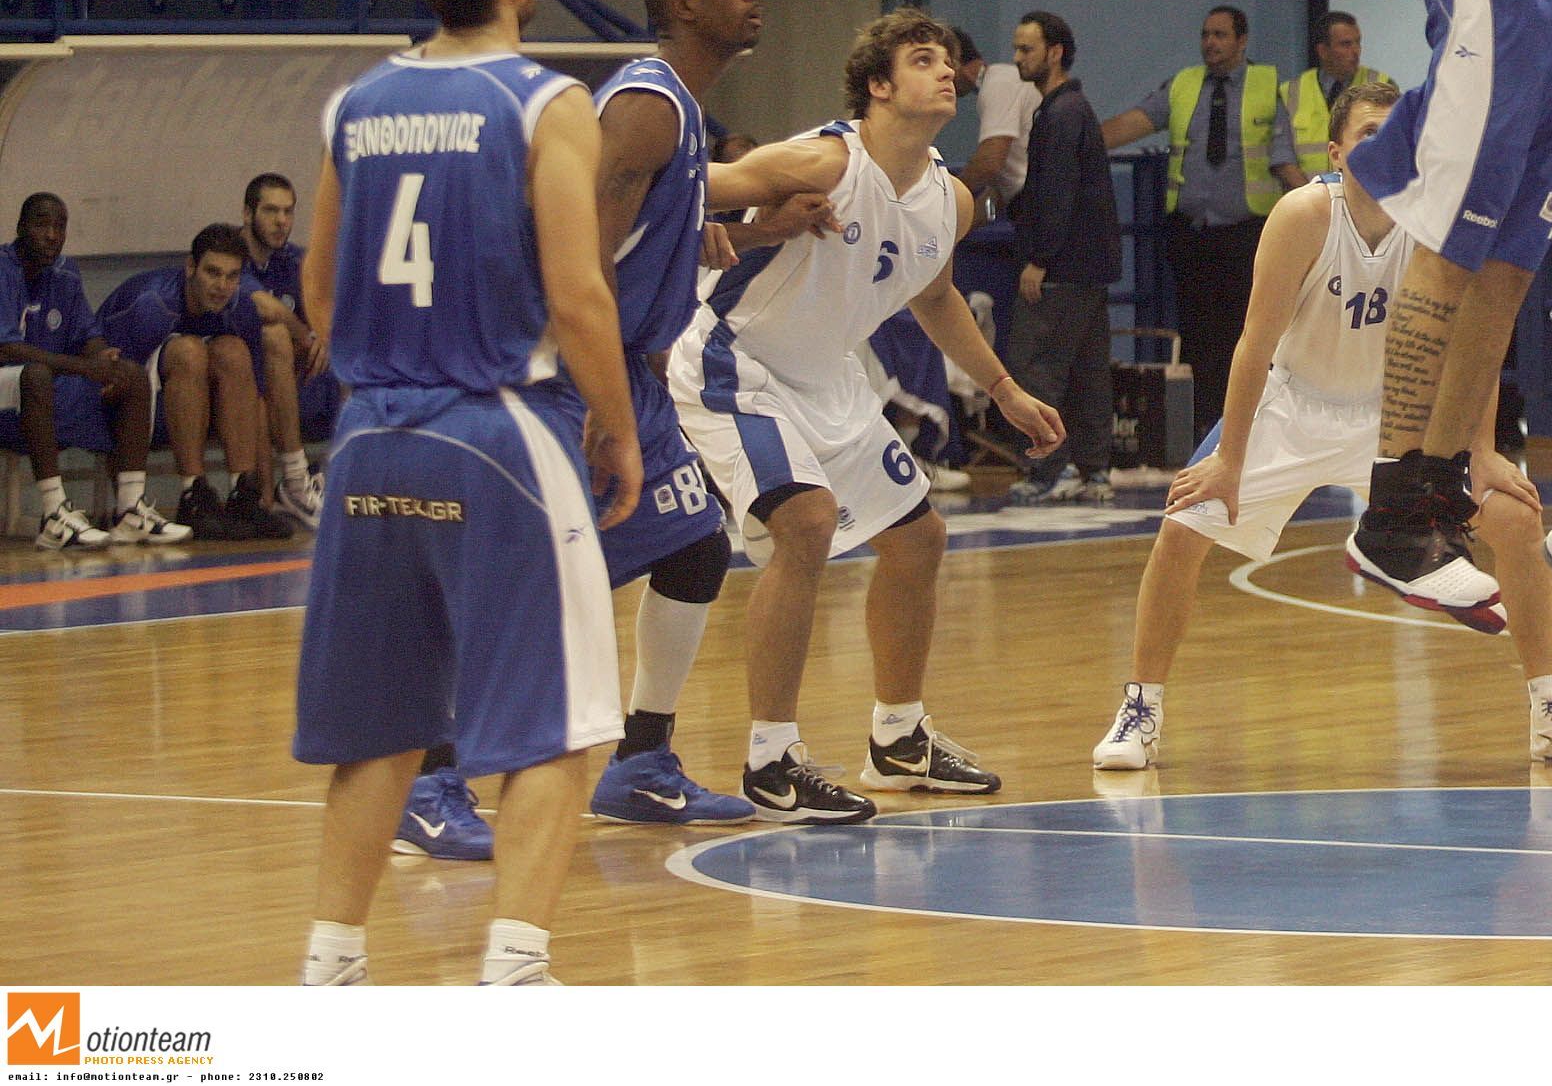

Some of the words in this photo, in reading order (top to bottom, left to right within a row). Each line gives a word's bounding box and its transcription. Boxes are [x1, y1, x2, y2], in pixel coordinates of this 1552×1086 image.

[379, 172, 435, 308] 4
[1345, 286, 1389, 330] 18
[882, 439, 918, 486] 6
